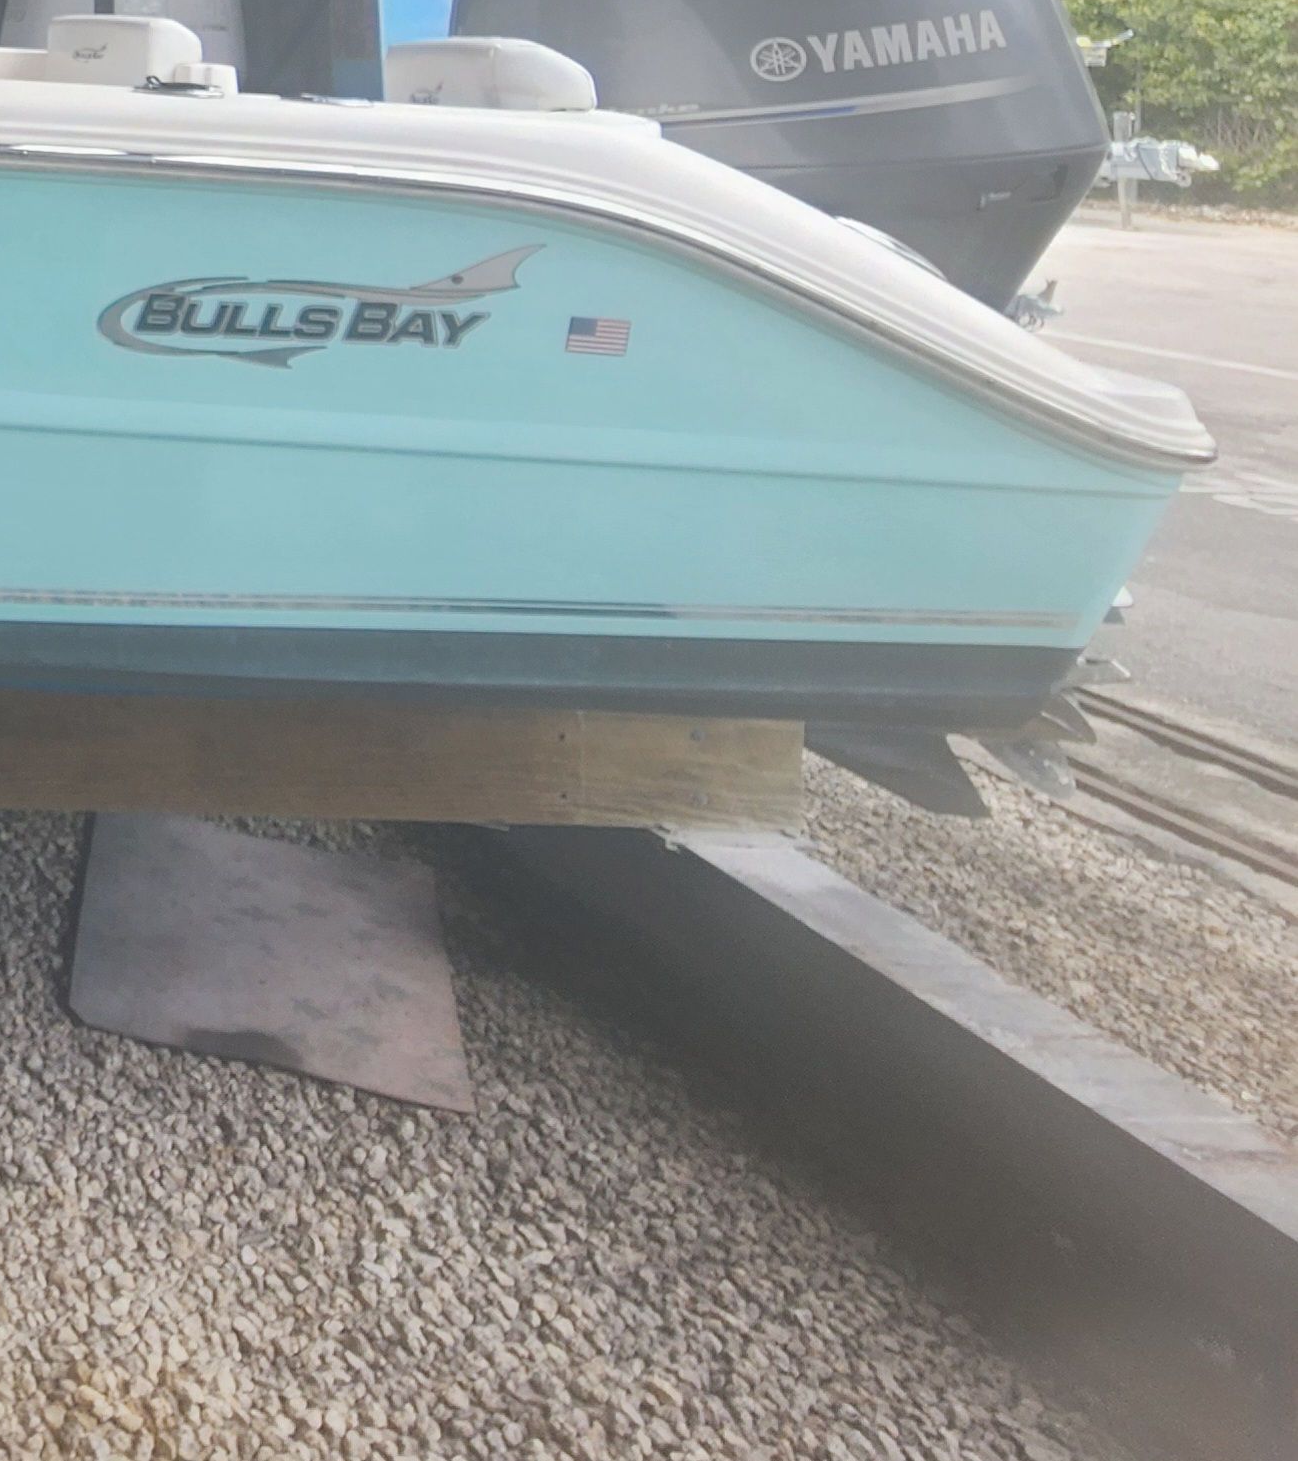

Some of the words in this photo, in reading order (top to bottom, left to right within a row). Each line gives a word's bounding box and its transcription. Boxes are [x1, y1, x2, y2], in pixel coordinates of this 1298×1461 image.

[806, 9, 1007, 73] YAMAHA
[134, 293, 342, 340] BULLS
[344, 301, 491, 349] BAY
